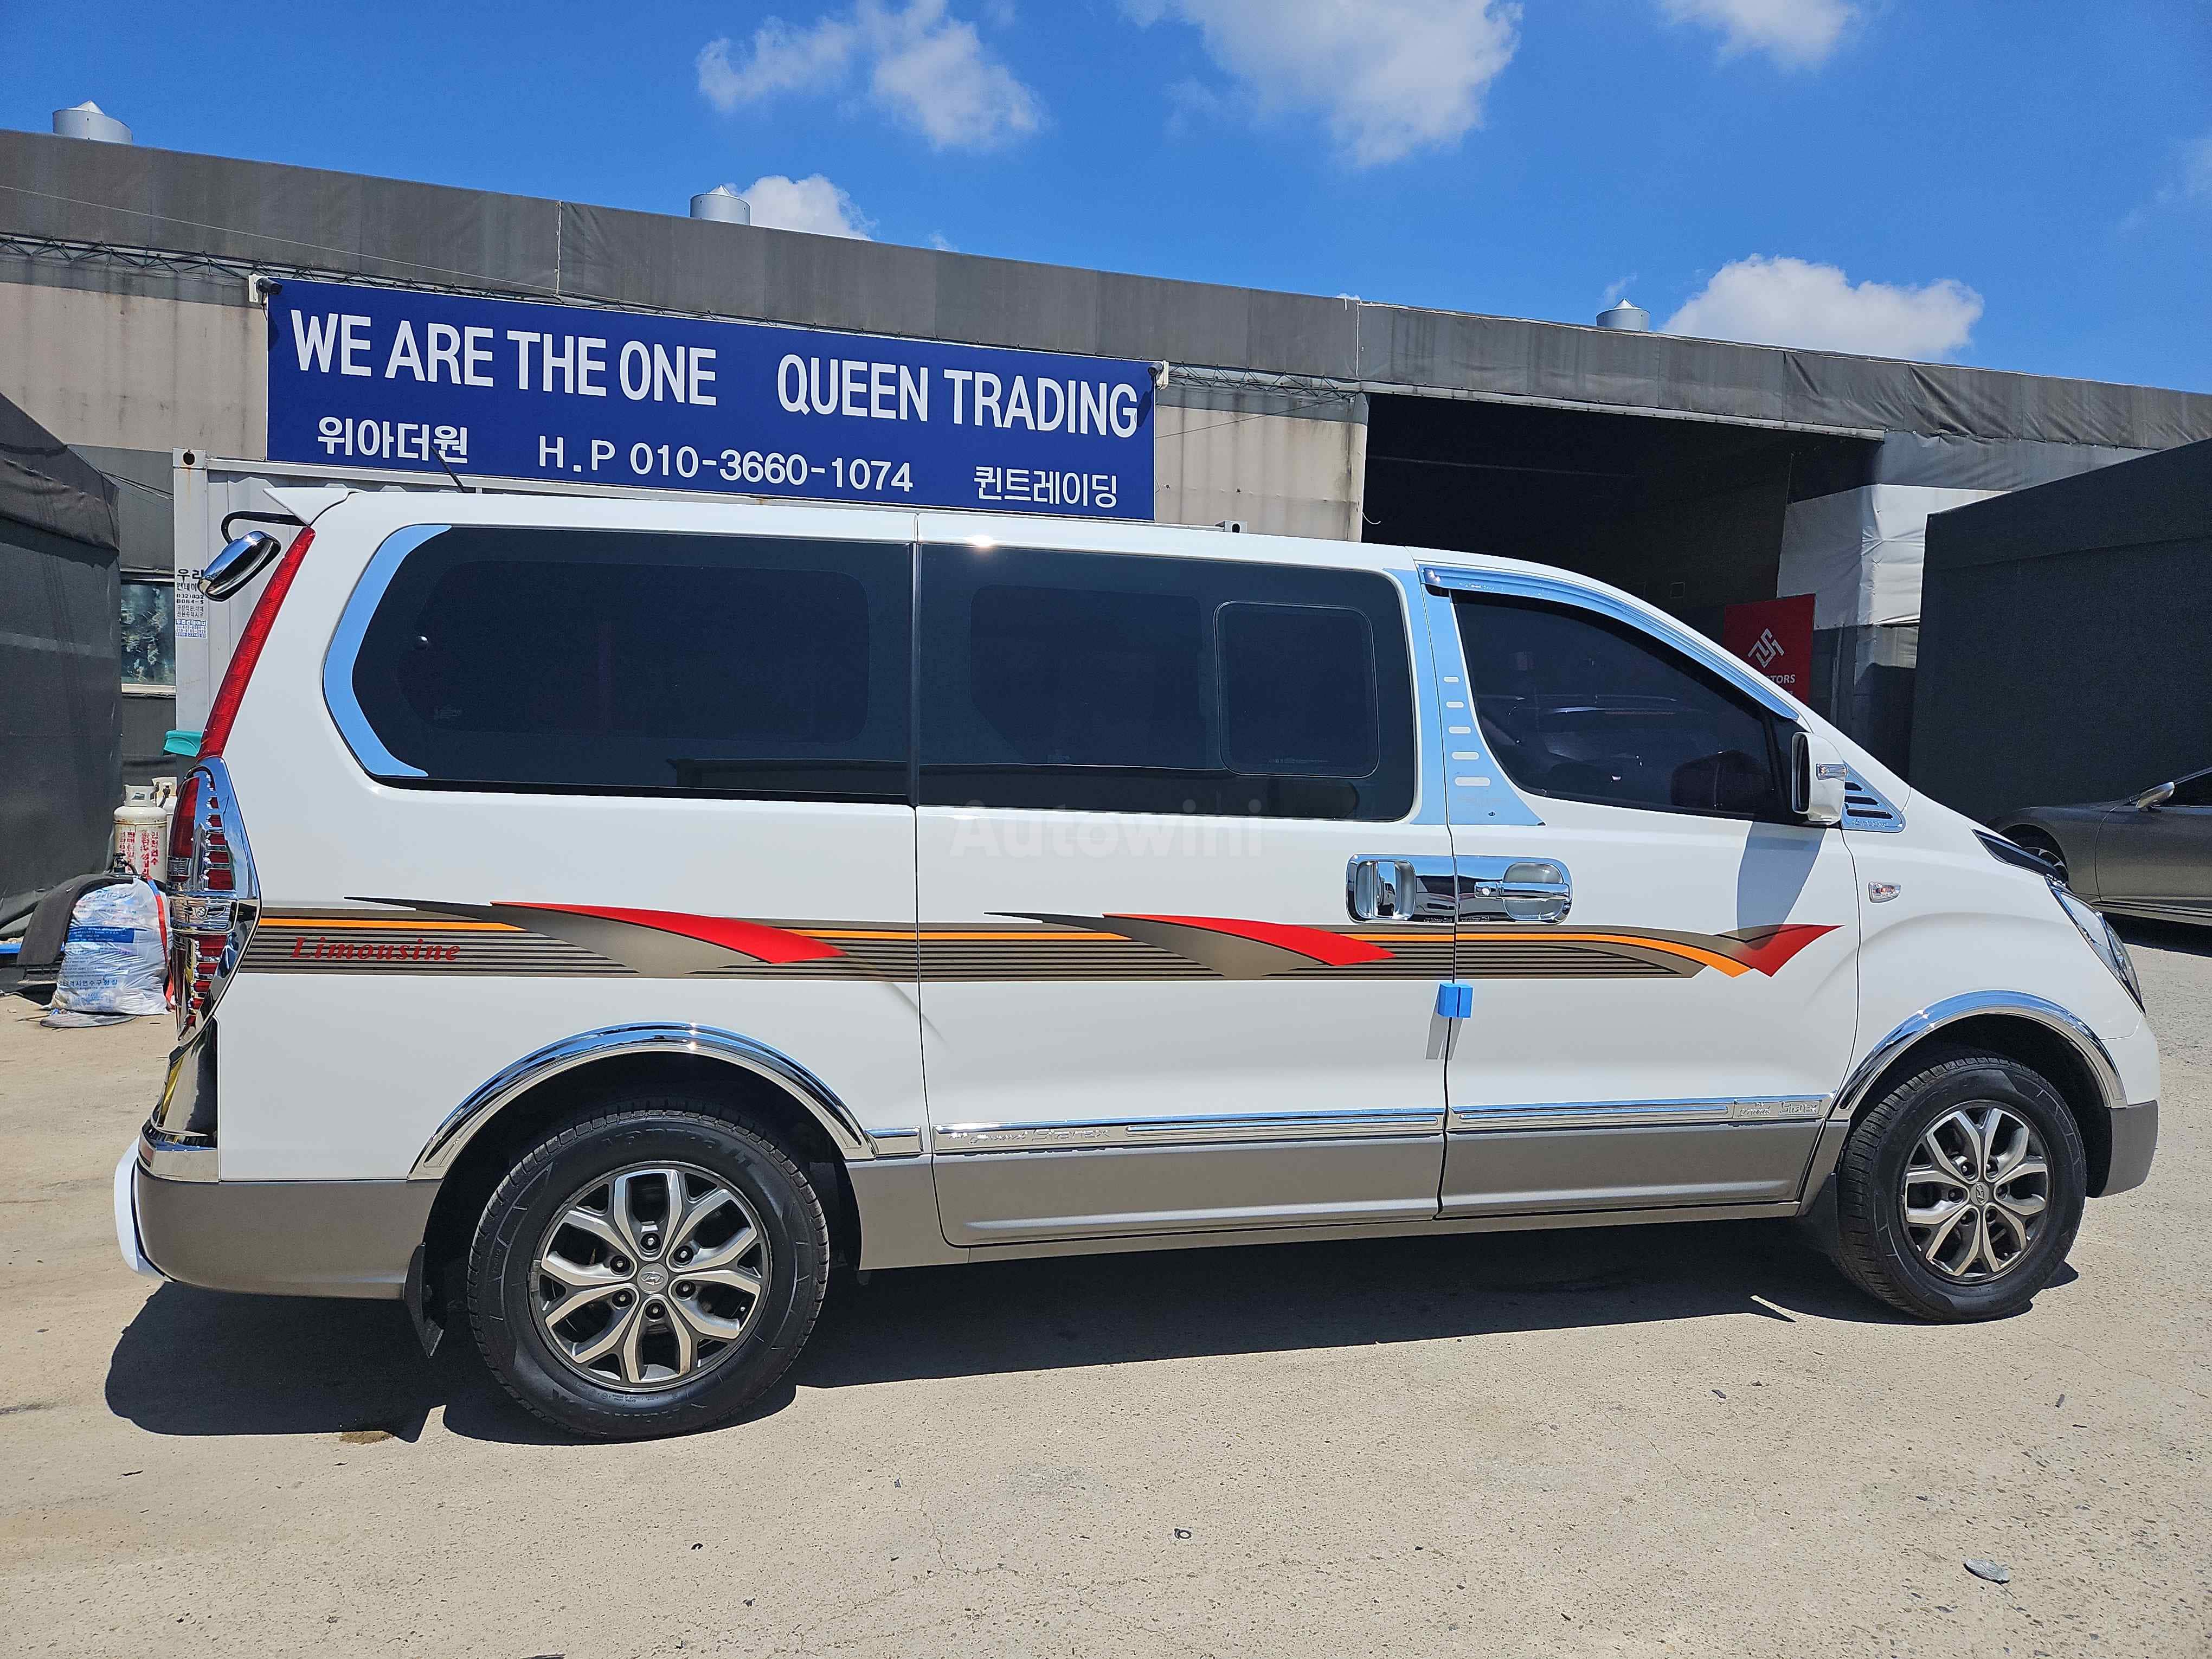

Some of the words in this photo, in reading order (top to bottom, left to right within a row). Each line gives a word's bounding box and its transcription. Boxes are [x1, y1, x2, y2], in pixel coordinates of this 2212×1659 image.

[291, 310, 371, 376] WE
[385, 320, 493, 387] ARE
[507, 330, 606, 396] THE
[620, 341, 716, 406] ONE
[778, 355, 928, 421] QUEEN
[944, 369, 1137, 438] TRADING
[318, 416, 467, 463] 위아더원
[631, 443, 912, 492] 010-3660-1074
[974, 466, 1117, 508] 퀸트레이딩
[177, 582, 197, 591] 컨테이
[289, 936, 460, 961] Limousine
